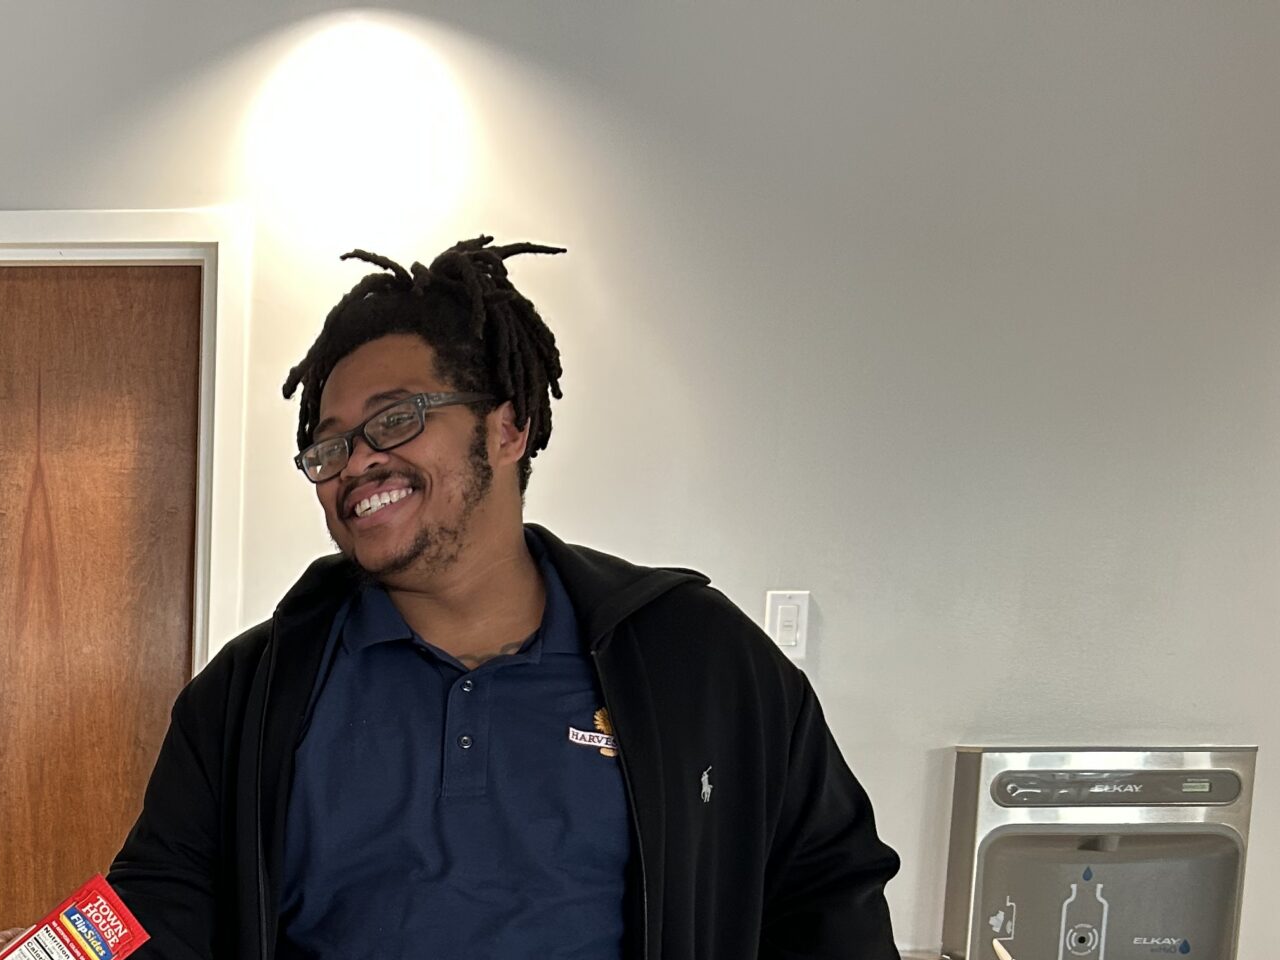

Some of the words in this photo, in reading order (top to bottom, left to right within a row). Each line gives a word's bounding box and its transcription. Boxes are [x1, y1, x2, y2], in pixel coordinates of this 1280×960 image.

[70, 913, 106, 957] FlipSides
[82, 903, 120, 948] HOUSE
[94, 896, 129, 938] TOWN
[43, 927, 70, 960] Nutrition
